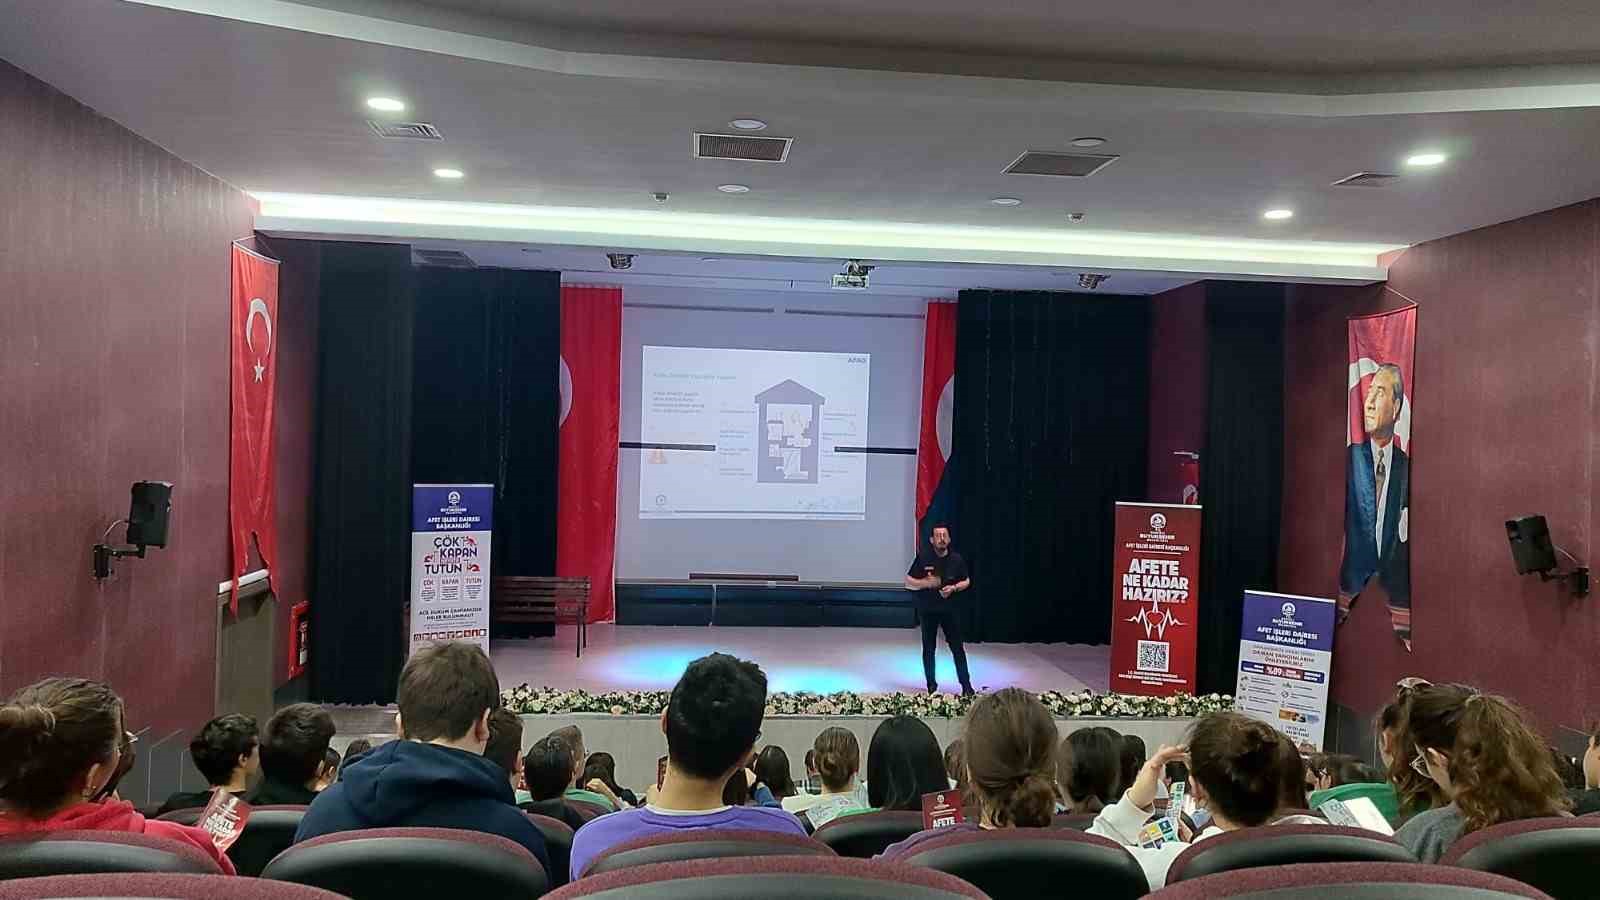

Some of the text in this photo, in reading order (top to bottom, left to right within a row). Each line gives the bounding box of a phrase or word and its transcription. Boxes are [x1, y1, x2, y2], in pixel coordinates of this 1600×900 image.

[434, 535, 459, 549] ÇÖK
[440, 548, 477, 558] KAPAN
[424, 564, 462, 574] TUTUN
[1129, 559, 1179, 576] AFETE
[1123, 574, 1189, 590] NE KADAR
[1123, 587, 1188, 603] HAZIRIZ?
[933, 816, 956, 830] AFETE
